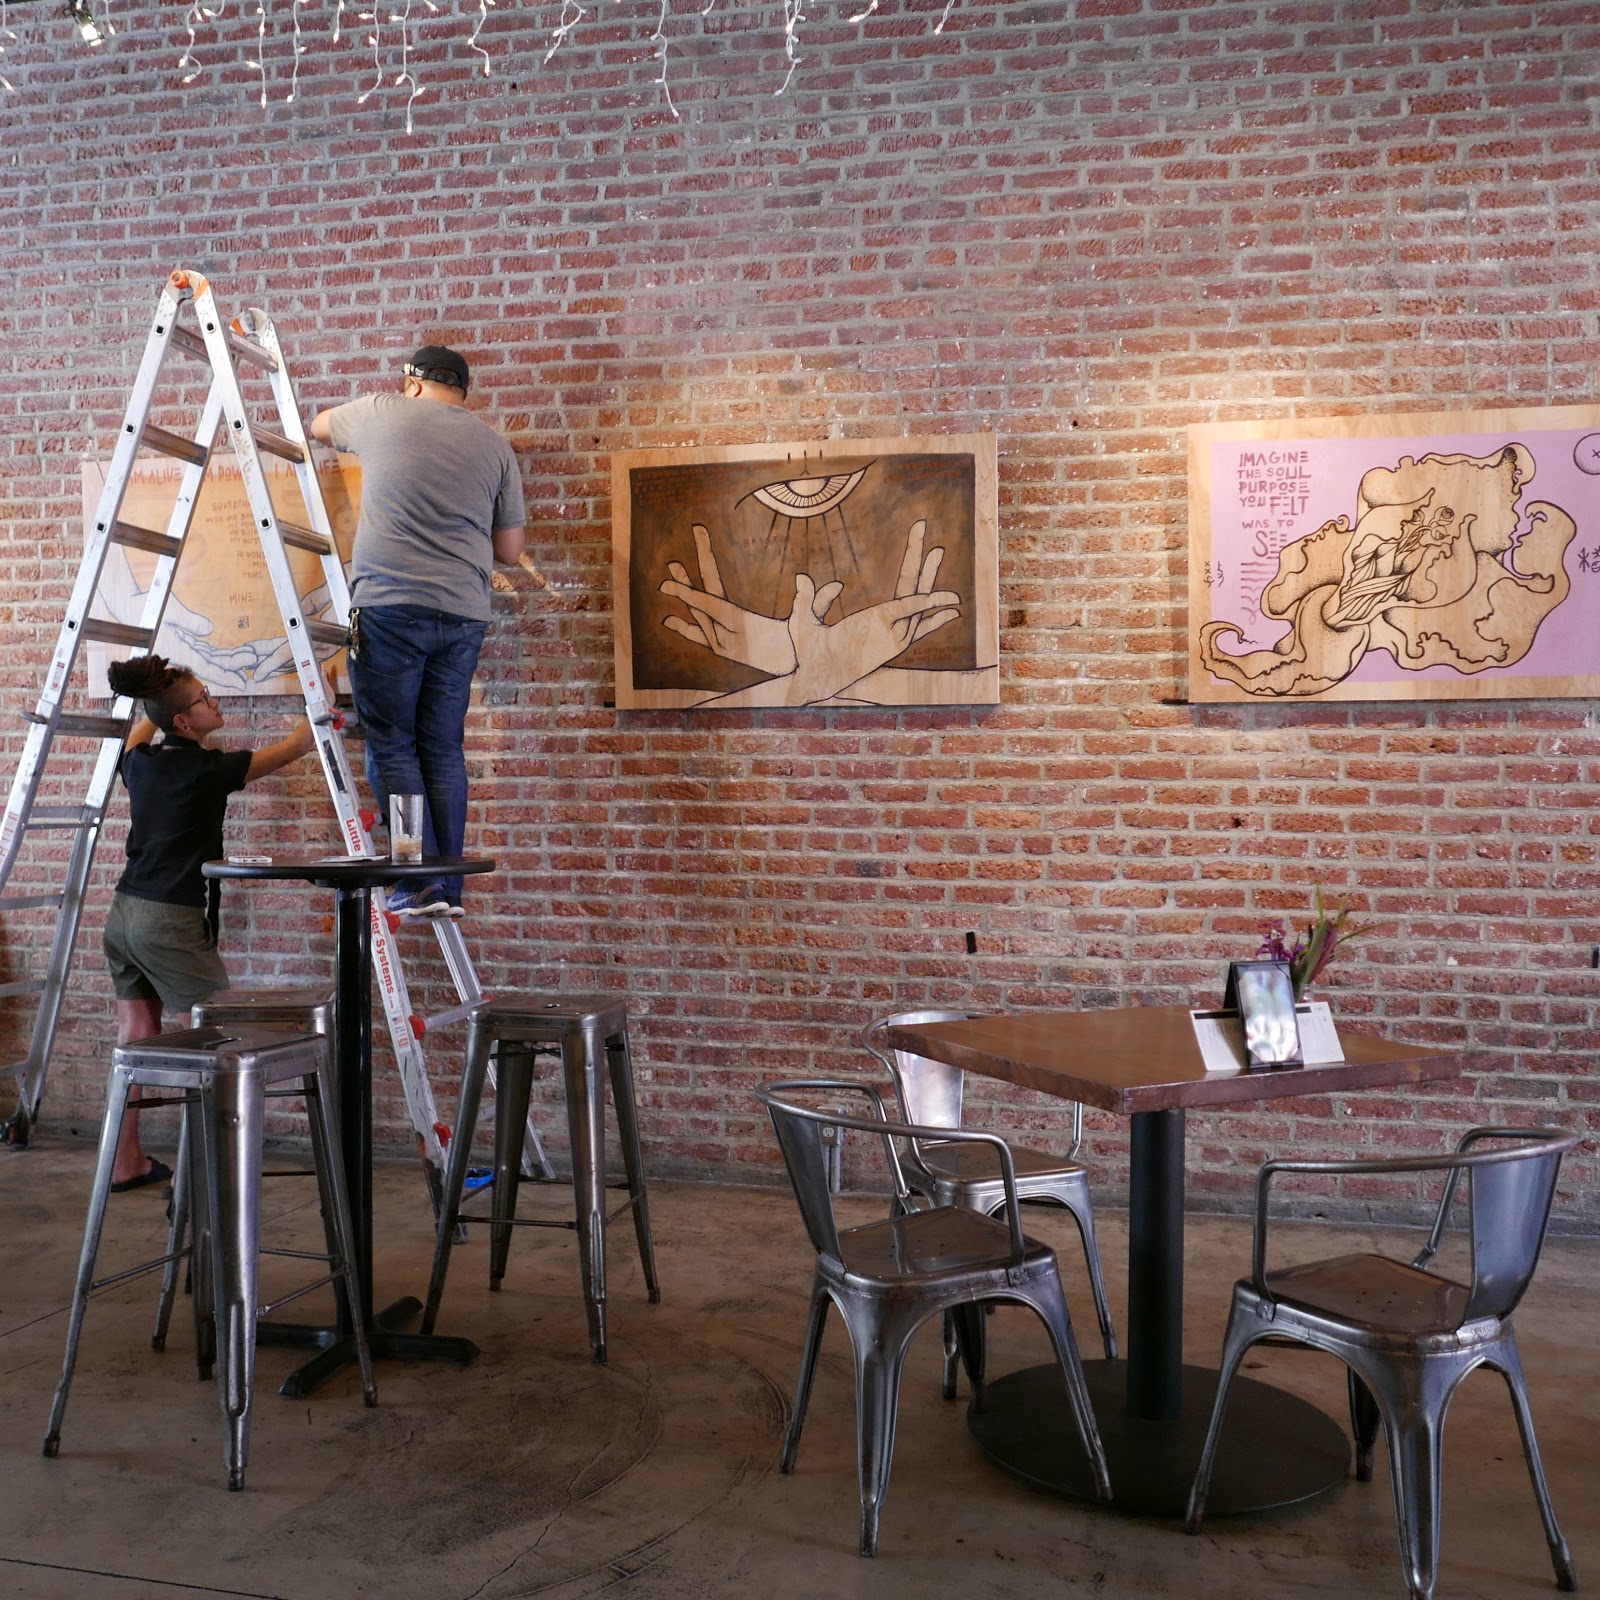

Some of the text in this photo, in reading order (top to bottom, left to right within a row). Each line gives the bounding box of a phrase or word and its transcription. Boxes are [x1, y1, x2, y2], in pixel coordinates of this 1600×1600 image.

[1239, 451, 1309, 467] IMAGINE
[218, 465, 243, 482] POW
[319, 459, 345, 475] IFE.
[1237, 466, 1312, 481] THE SOUL
[1239, 481, 1310, 495] PURPOSE
[211, 499, 251, 511] SOVEREIG
[1240, 496, 1309, 516] YOU FELT
[1242, 520, 1269, 529] WAS
[345, 817, 361, 852] Little
[370, 899, 381, 935] adder
[376, 938, 394, 994] Systems
